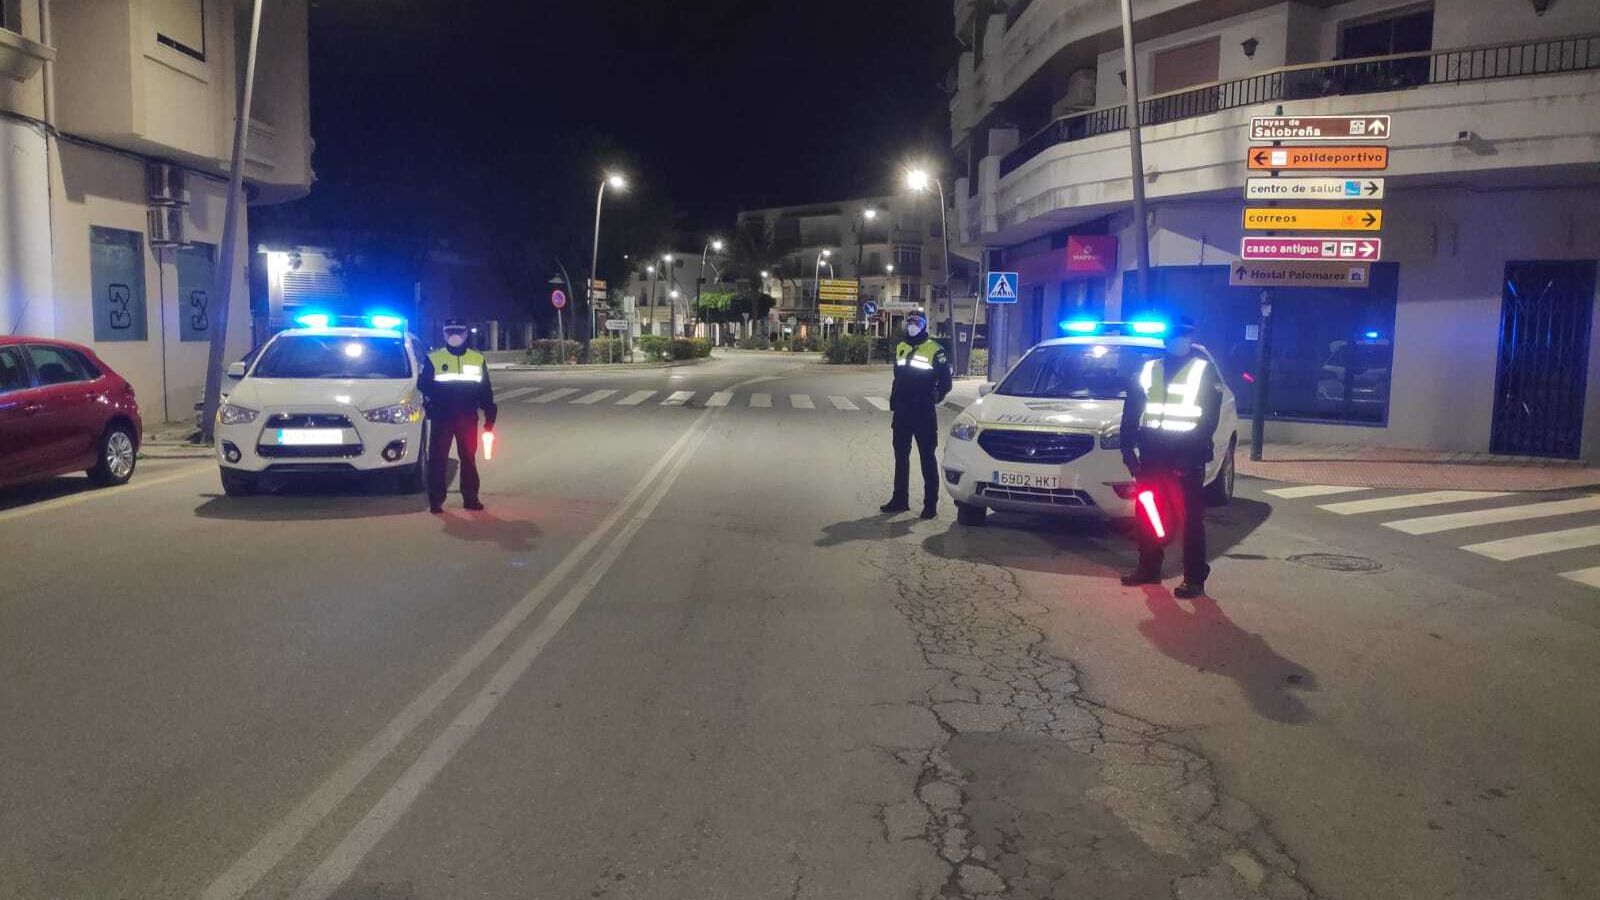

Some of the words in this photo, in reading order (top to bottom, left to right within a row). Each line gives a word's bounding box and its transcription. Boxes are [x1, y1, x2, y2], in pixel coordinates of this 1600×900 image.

[1255, 119, 1283, 127] playas
[1255, 127, 1320, 137] Salobreña
[1293, 152, 1382, 163] polideportivo
[1250, 183, 1288, 194] centro
[1292, 183, 1306, 193] de
[1310, 183, 1342, 193] salud
[1248, 213, 1297, 223] correos
[1246, 243, 1277, 254] casco
[1280, 242, 1319, 256] antiguo
[1250, 269, 1286, 280] Hostal
[1289, 270, 1346, 282] Palomares
[1001, 473, 1031, 486] 6902
